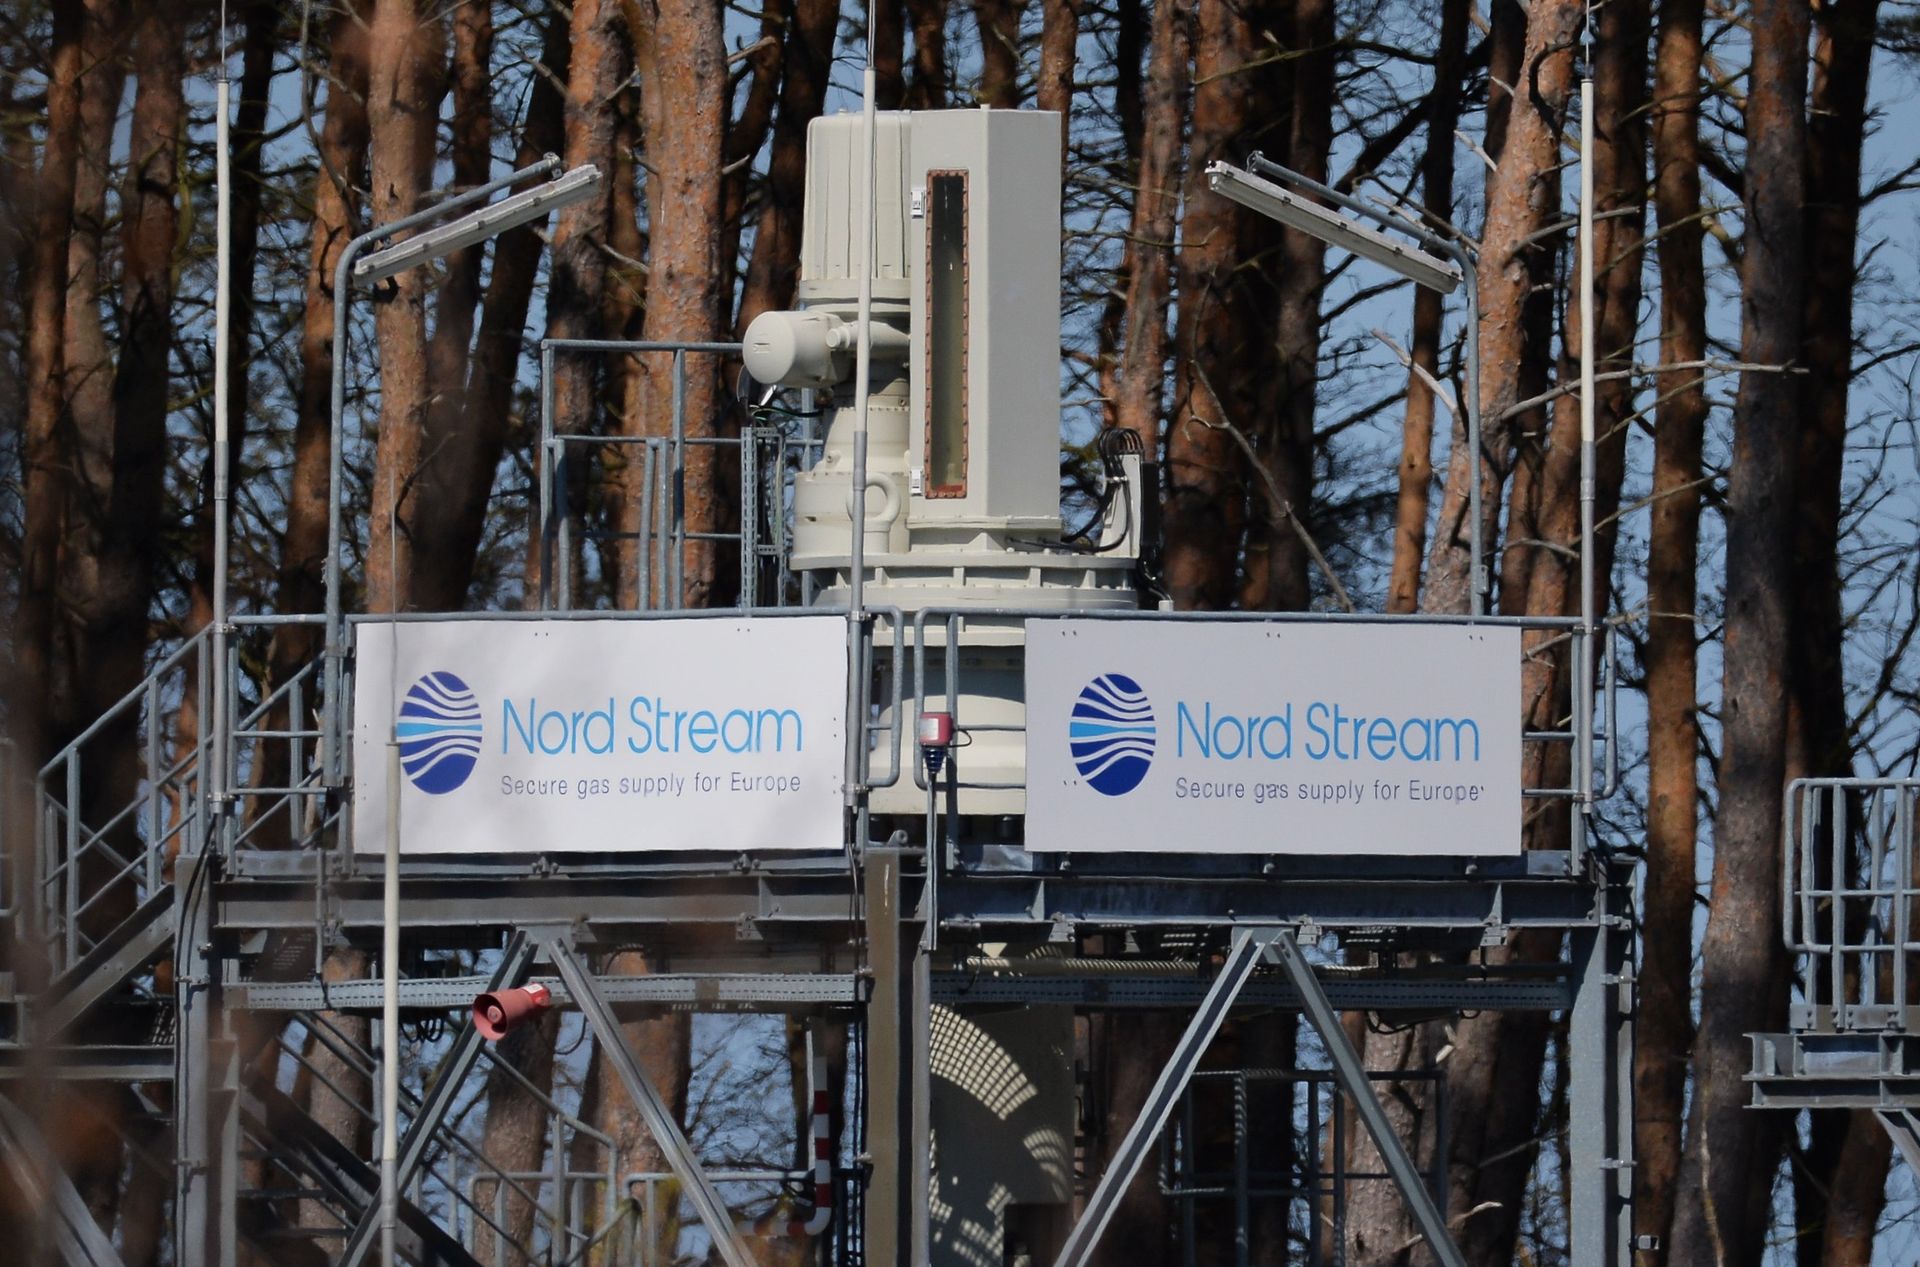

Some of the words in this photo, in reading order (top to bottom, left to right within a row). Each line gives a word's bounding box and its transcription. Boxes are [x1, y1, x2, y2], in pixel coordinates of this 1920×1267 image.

[502, 696, 615, 755] Nord
[628, 696, 802, 753] Stream
[1177, 701, 1292, 760] Nord
[1305, 702, 1480, 762] Stream
[501, 775, 568, 795] Secure
[578, 779, 610, 799] gas
[620, 773, 684, 797] supply
[694, 772, 721, 792] for
[731, 772, 801, 796] Europe
[1175, 777, 1245, 799] Secure
[1254, 783, 1289, 804] gas
[1298, 779, 1364, 804] supply
[1374, 779, 1401, 800] for
[1410, 780, 1478, 804] Europe
